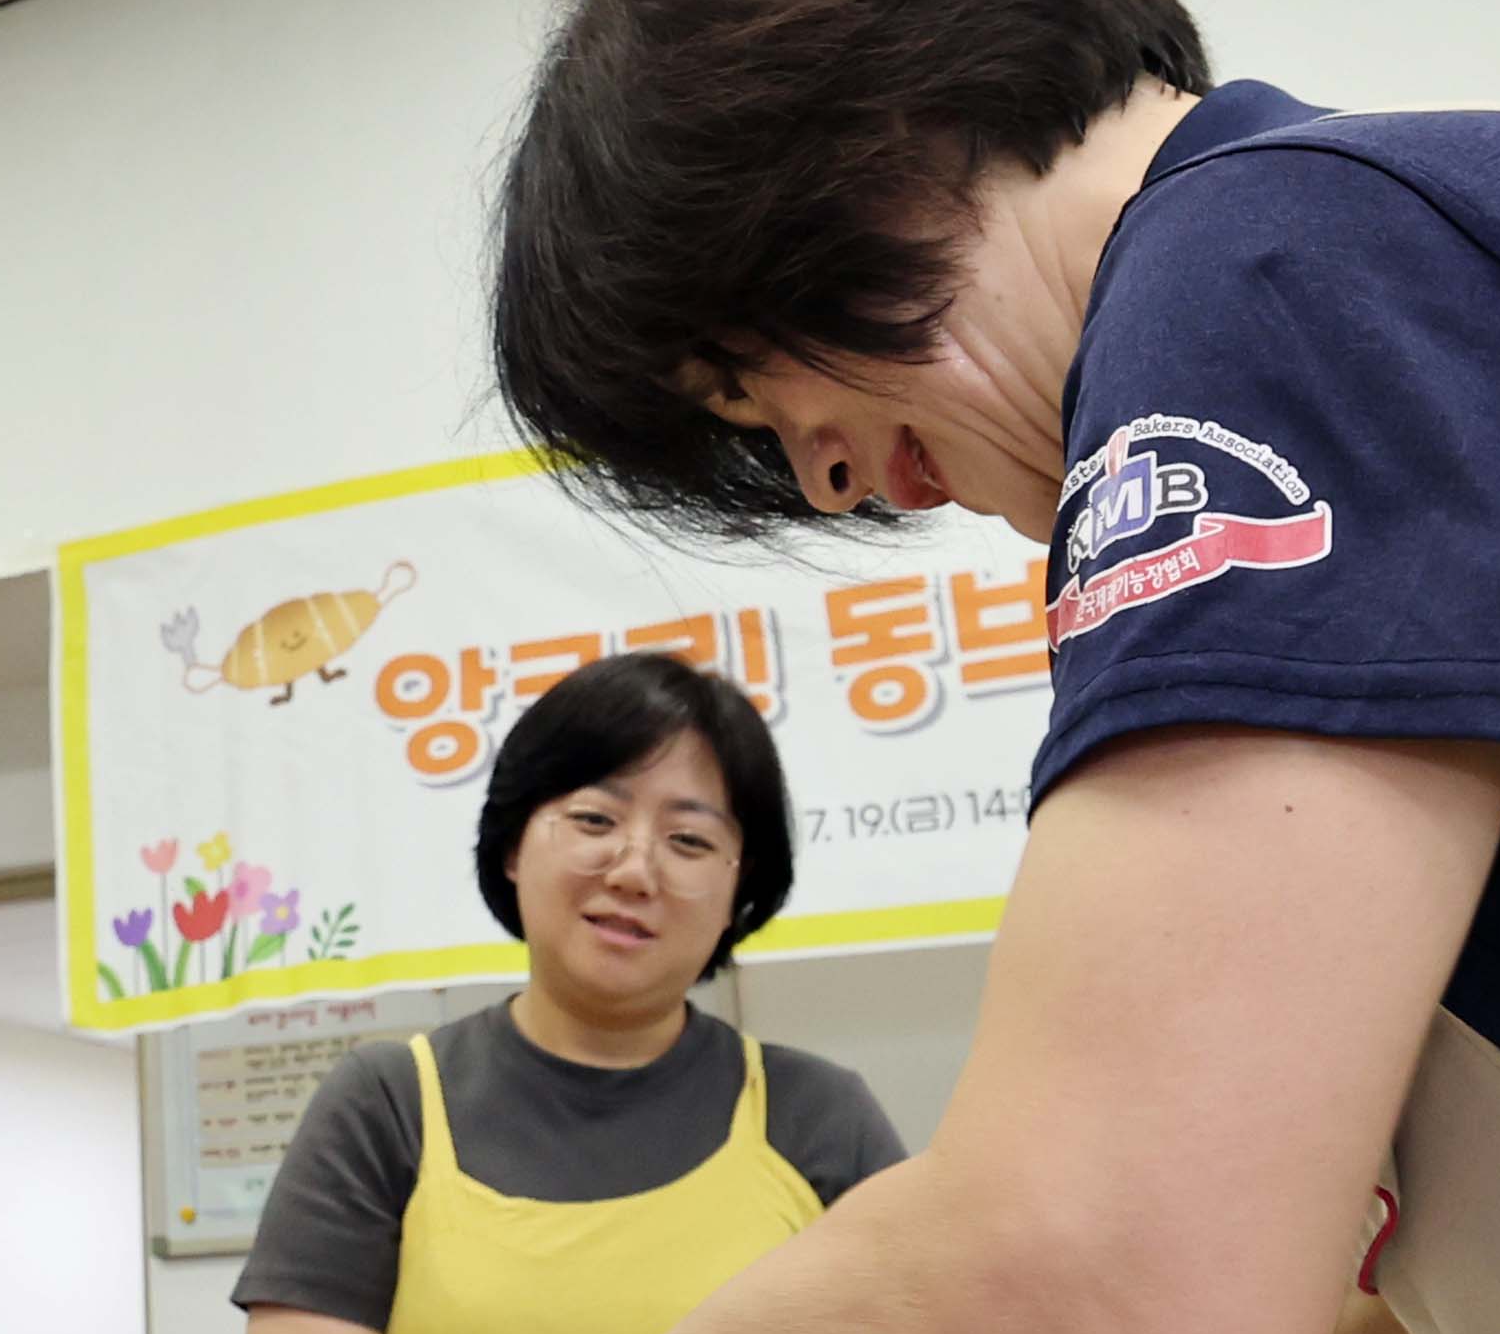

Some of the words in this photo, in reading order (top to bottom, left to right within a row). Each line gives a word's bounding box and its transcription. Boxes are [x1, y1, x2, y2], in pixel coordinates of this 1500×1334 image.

[1133, 418, 1194, 437] Bakers
[1202, 426, 1305, 500] Association
[825, 559, 1050, 722] 동브
